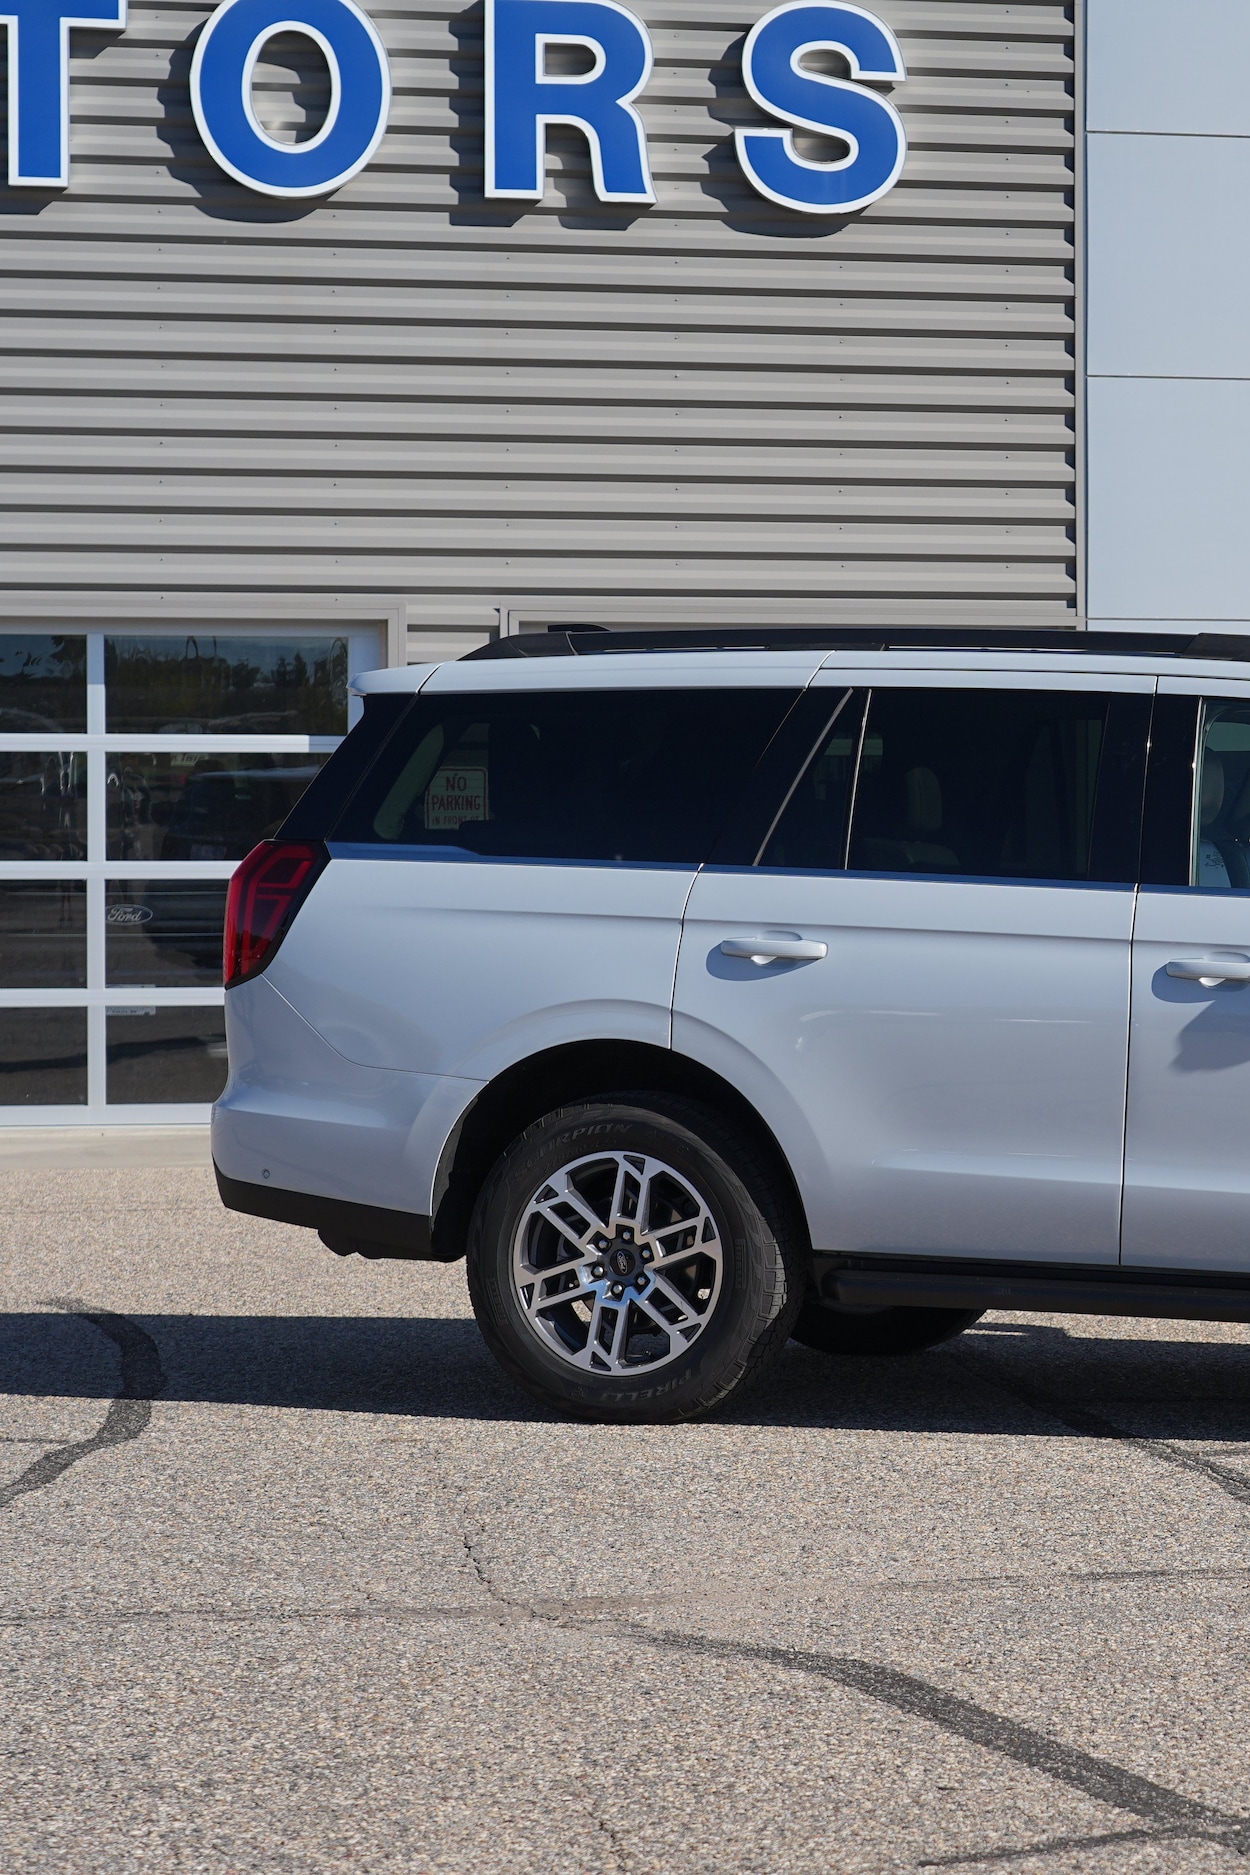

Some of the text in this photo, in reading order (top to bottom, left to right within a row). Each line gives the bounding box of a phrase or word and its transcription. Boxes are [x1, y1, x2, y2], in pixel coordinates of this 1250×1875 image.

[446, 776, 467, 792] NO
[431, 795, 481, 811] PARKING
[107, 906, 143, 922] Ford
